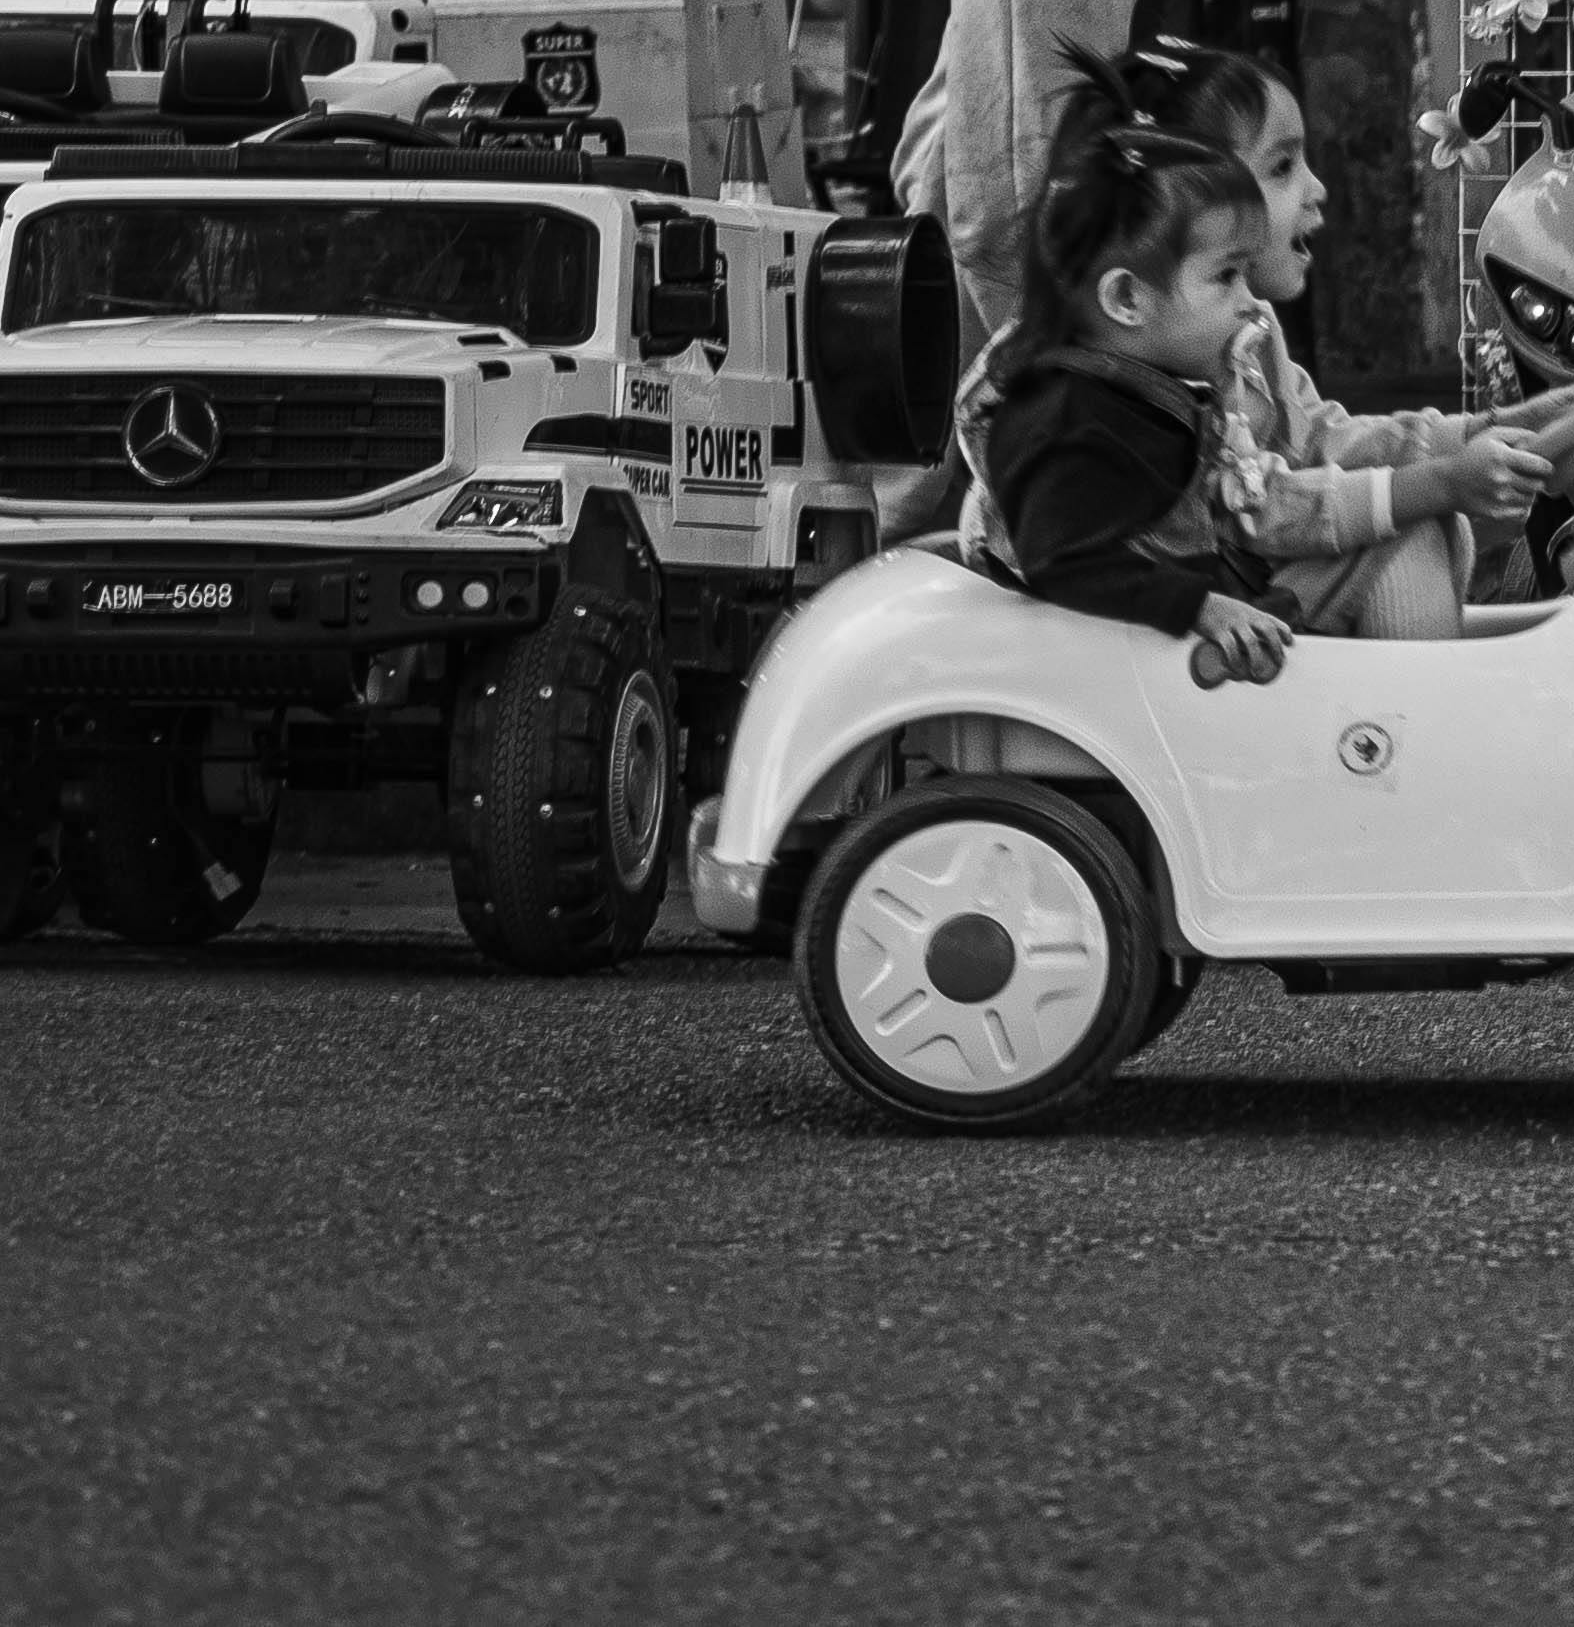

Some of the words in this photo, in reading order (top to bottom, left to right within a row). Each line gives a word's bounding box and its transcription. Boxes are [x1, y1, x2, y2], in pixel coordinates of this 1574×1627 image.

[536, 34, 583, 51] SUPER
[630, 379, 670, 415] SPORT
[685, 425, 763, 480] POWER
